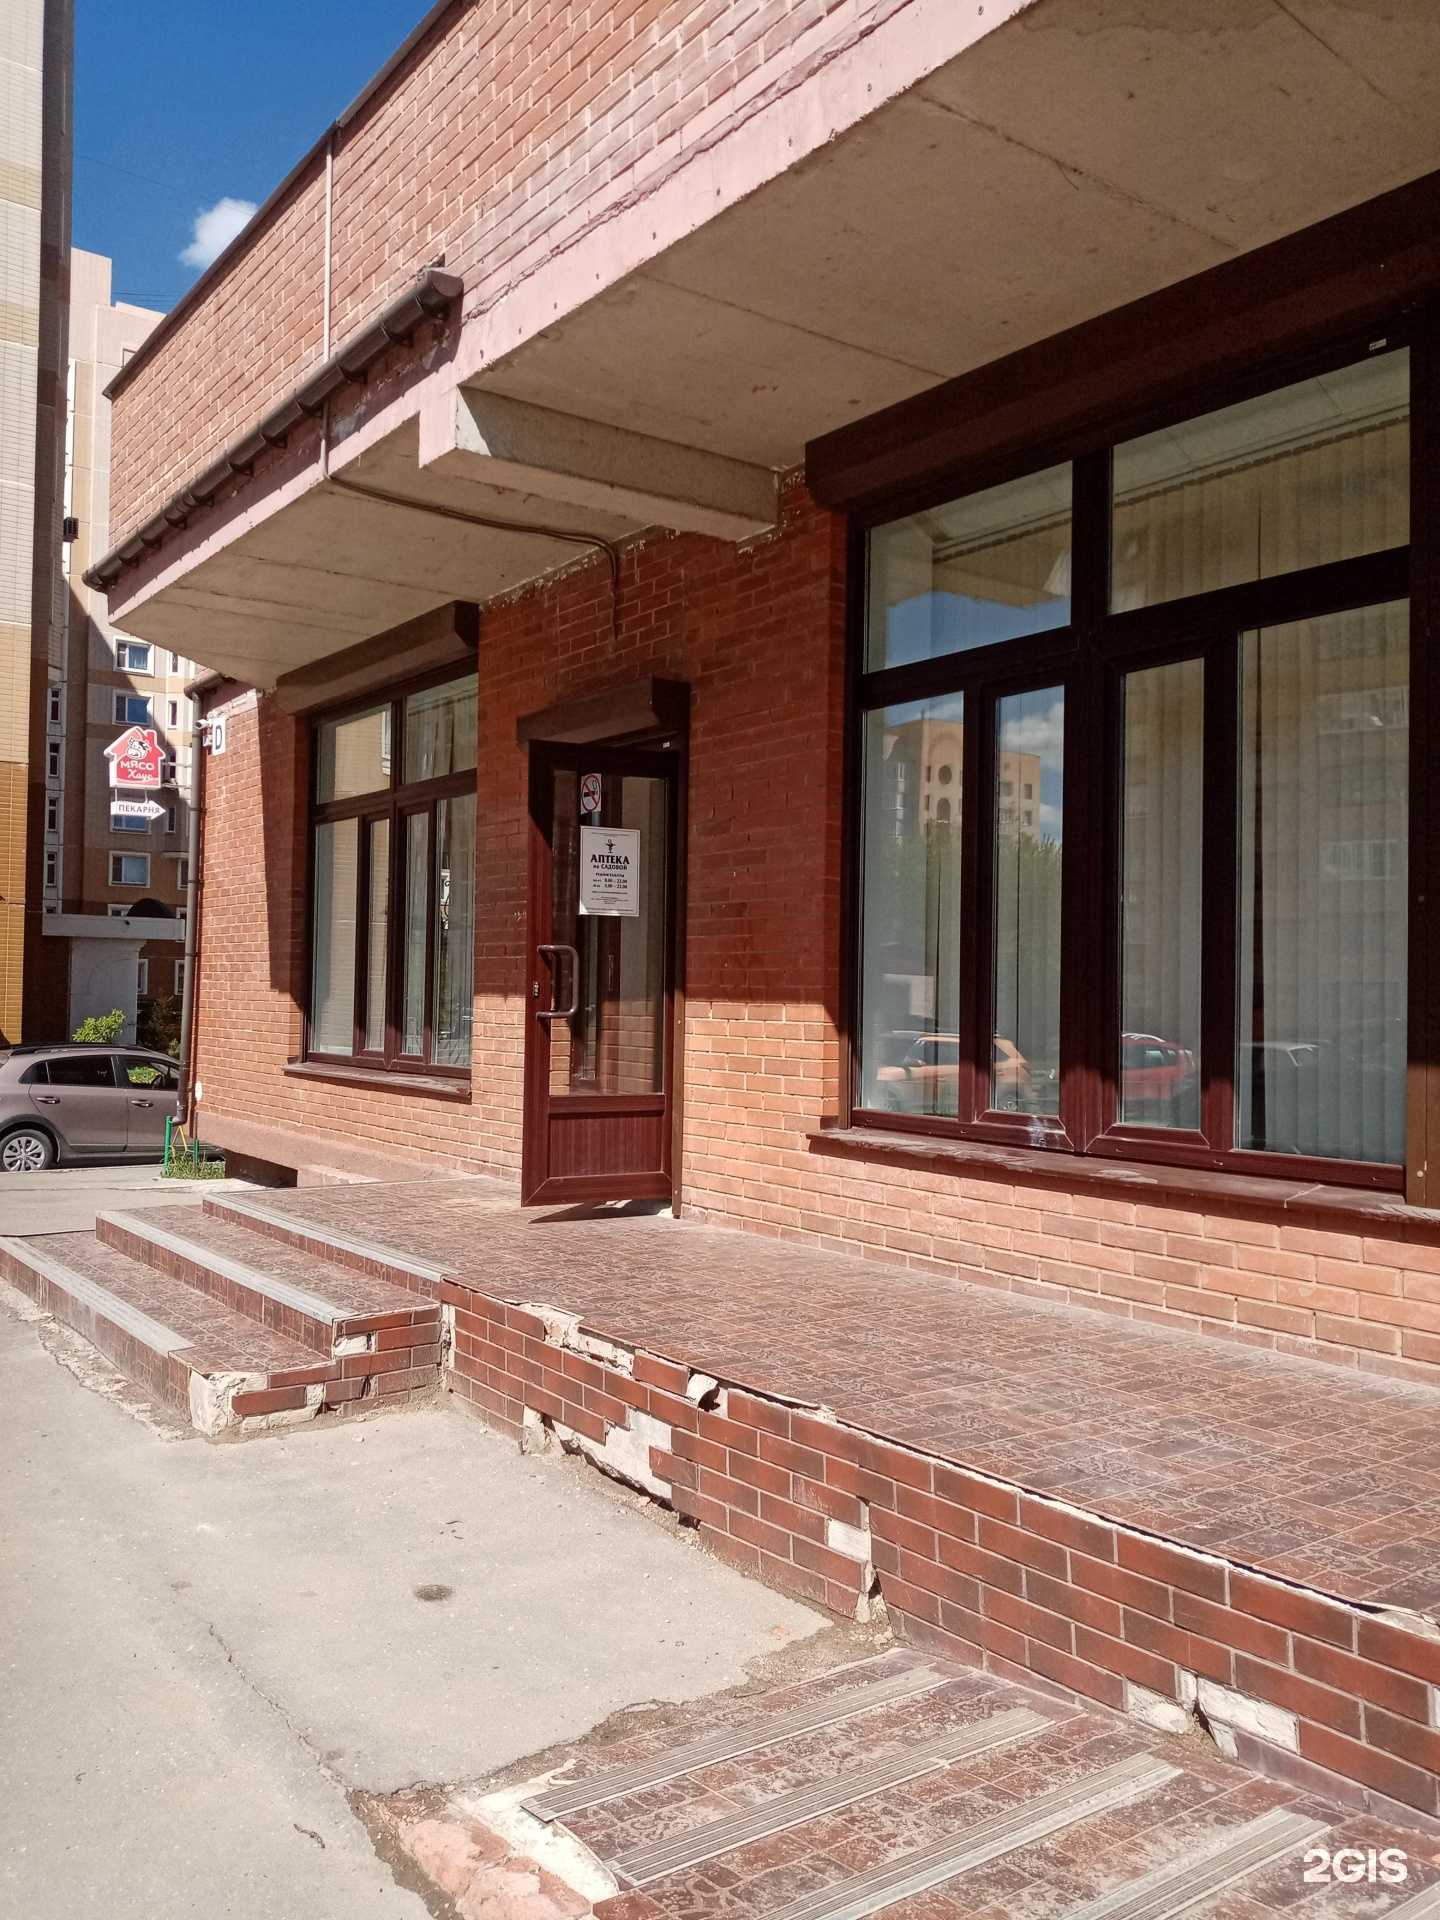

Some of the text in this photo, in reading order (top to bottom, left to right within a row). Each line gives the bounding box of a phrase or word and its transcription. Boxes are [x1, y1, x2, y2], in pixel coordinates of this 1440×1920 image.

[120, 761, 154, 770] МЯСО
[118, 804, 160, 813] ПЕКАРНЯ
[591, 854, 630, 865] АПТЕКА
